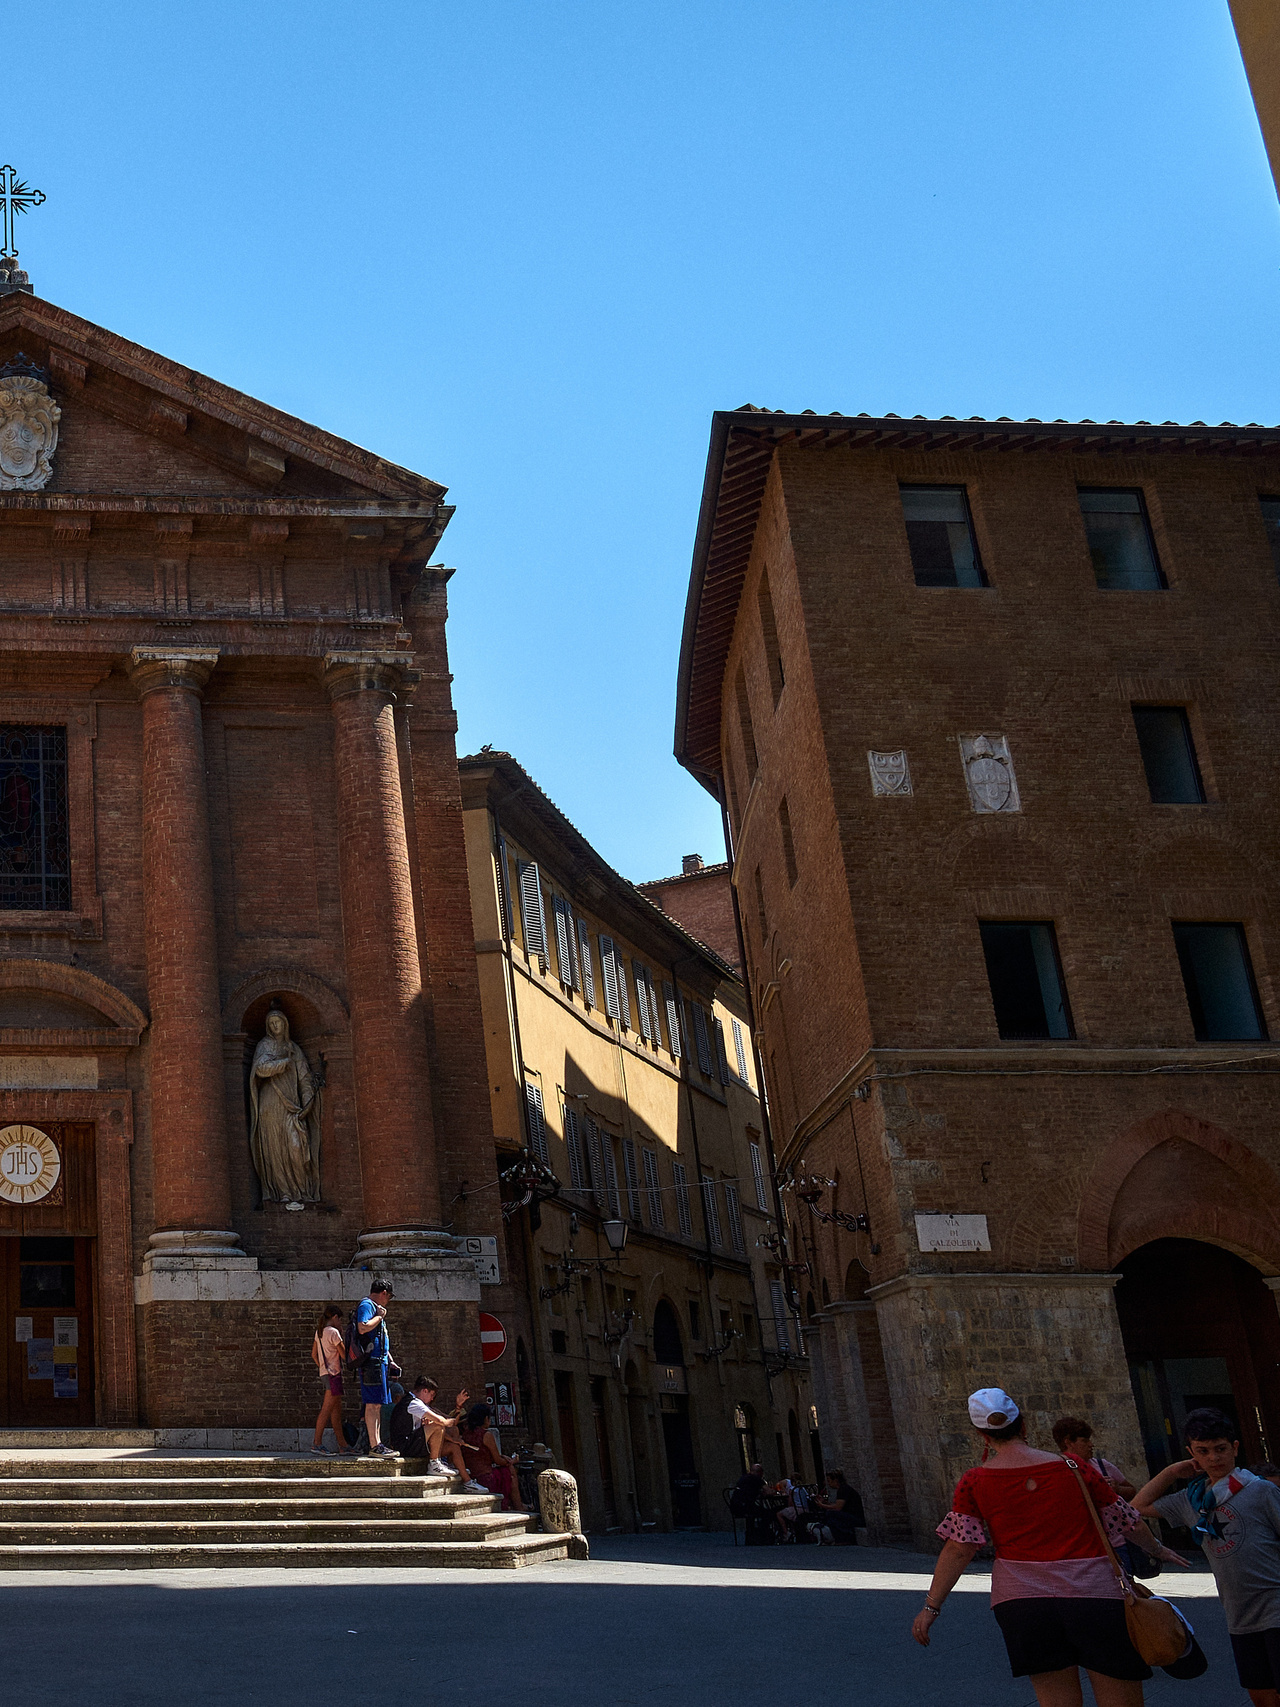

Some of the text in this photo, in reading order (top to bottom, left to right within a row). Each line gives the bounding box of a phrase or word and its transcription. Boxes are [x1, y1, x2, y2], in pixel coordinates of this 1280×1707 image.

[944, 1219, 960, 1227] VIA
[929, 1239, 982, 1247] CALZOLERIA
[1216, 1540, 1236, 1554] STAR
